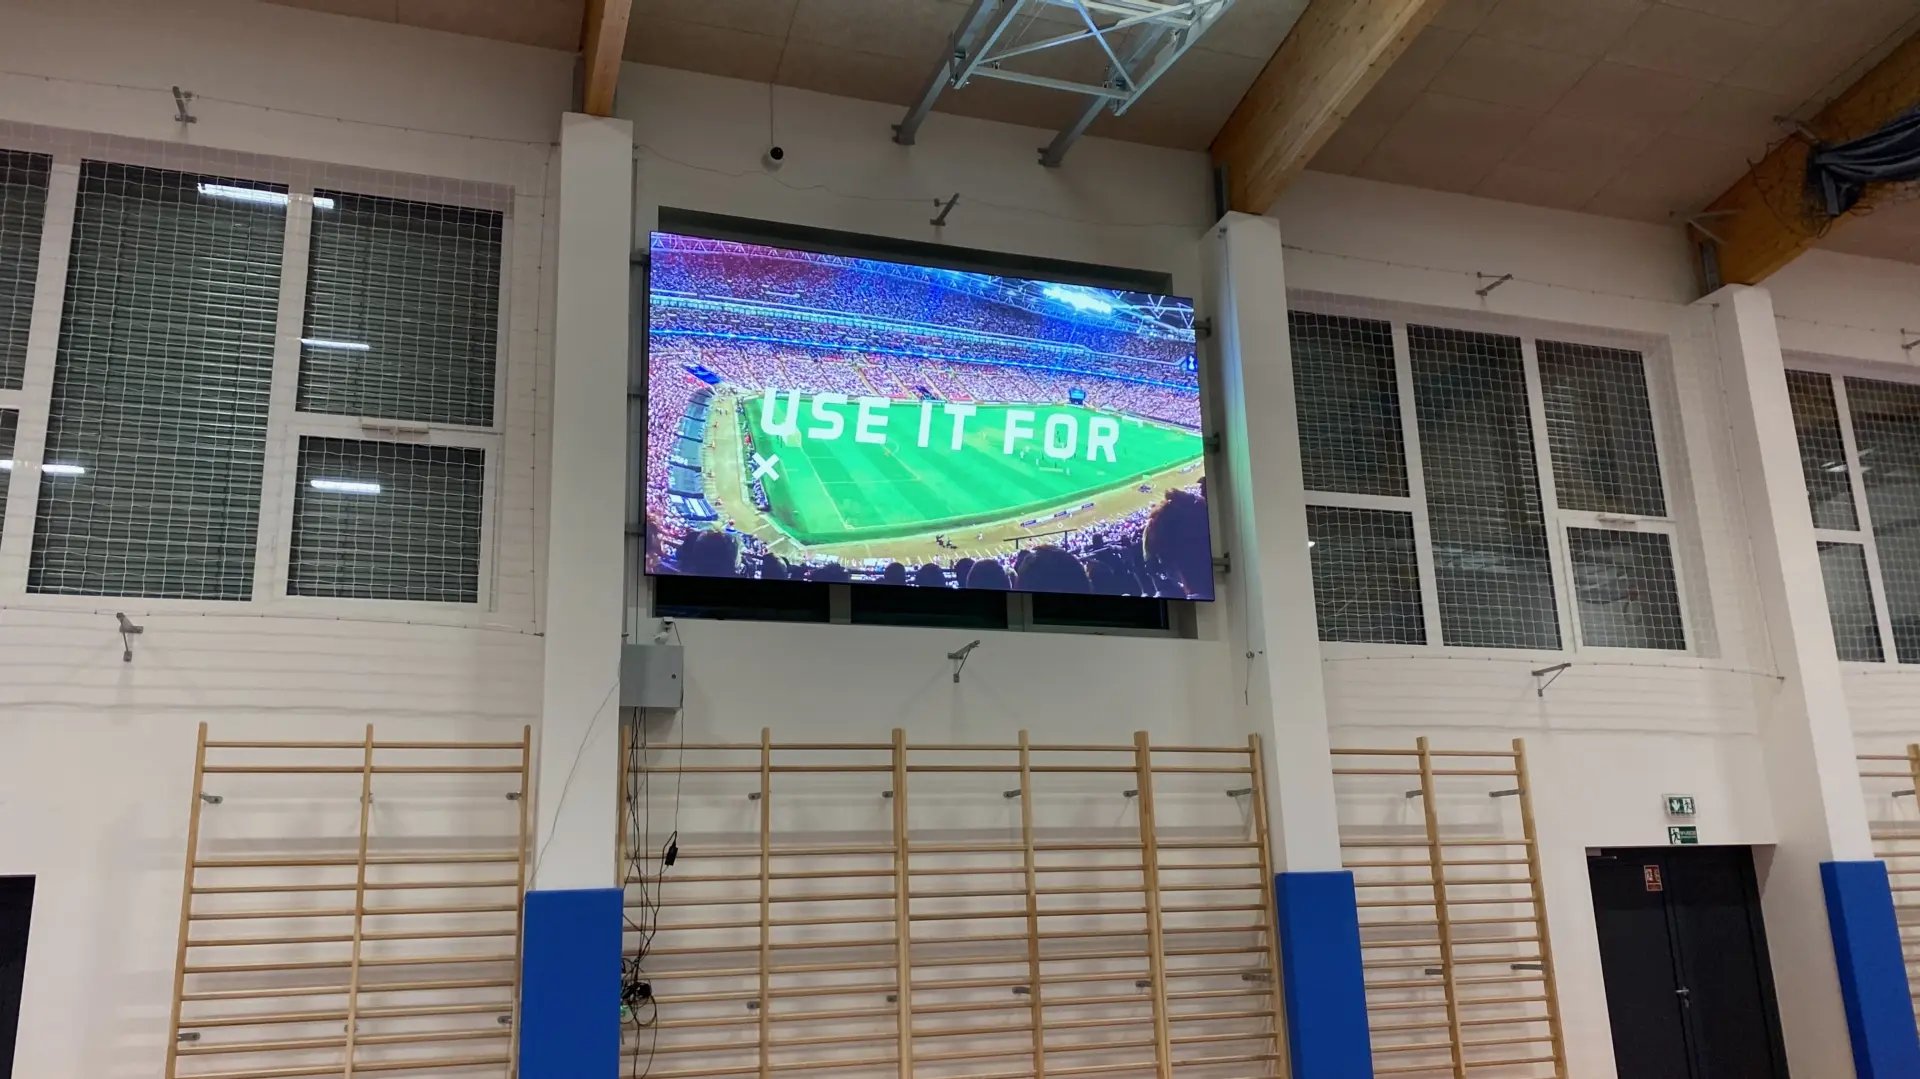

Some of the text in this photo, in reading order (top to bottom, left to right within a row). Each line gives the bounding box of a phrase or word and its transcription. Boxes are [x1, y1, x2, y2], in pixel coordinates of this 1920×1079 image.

[761, 388, 1120, 463] USE IT FOR
